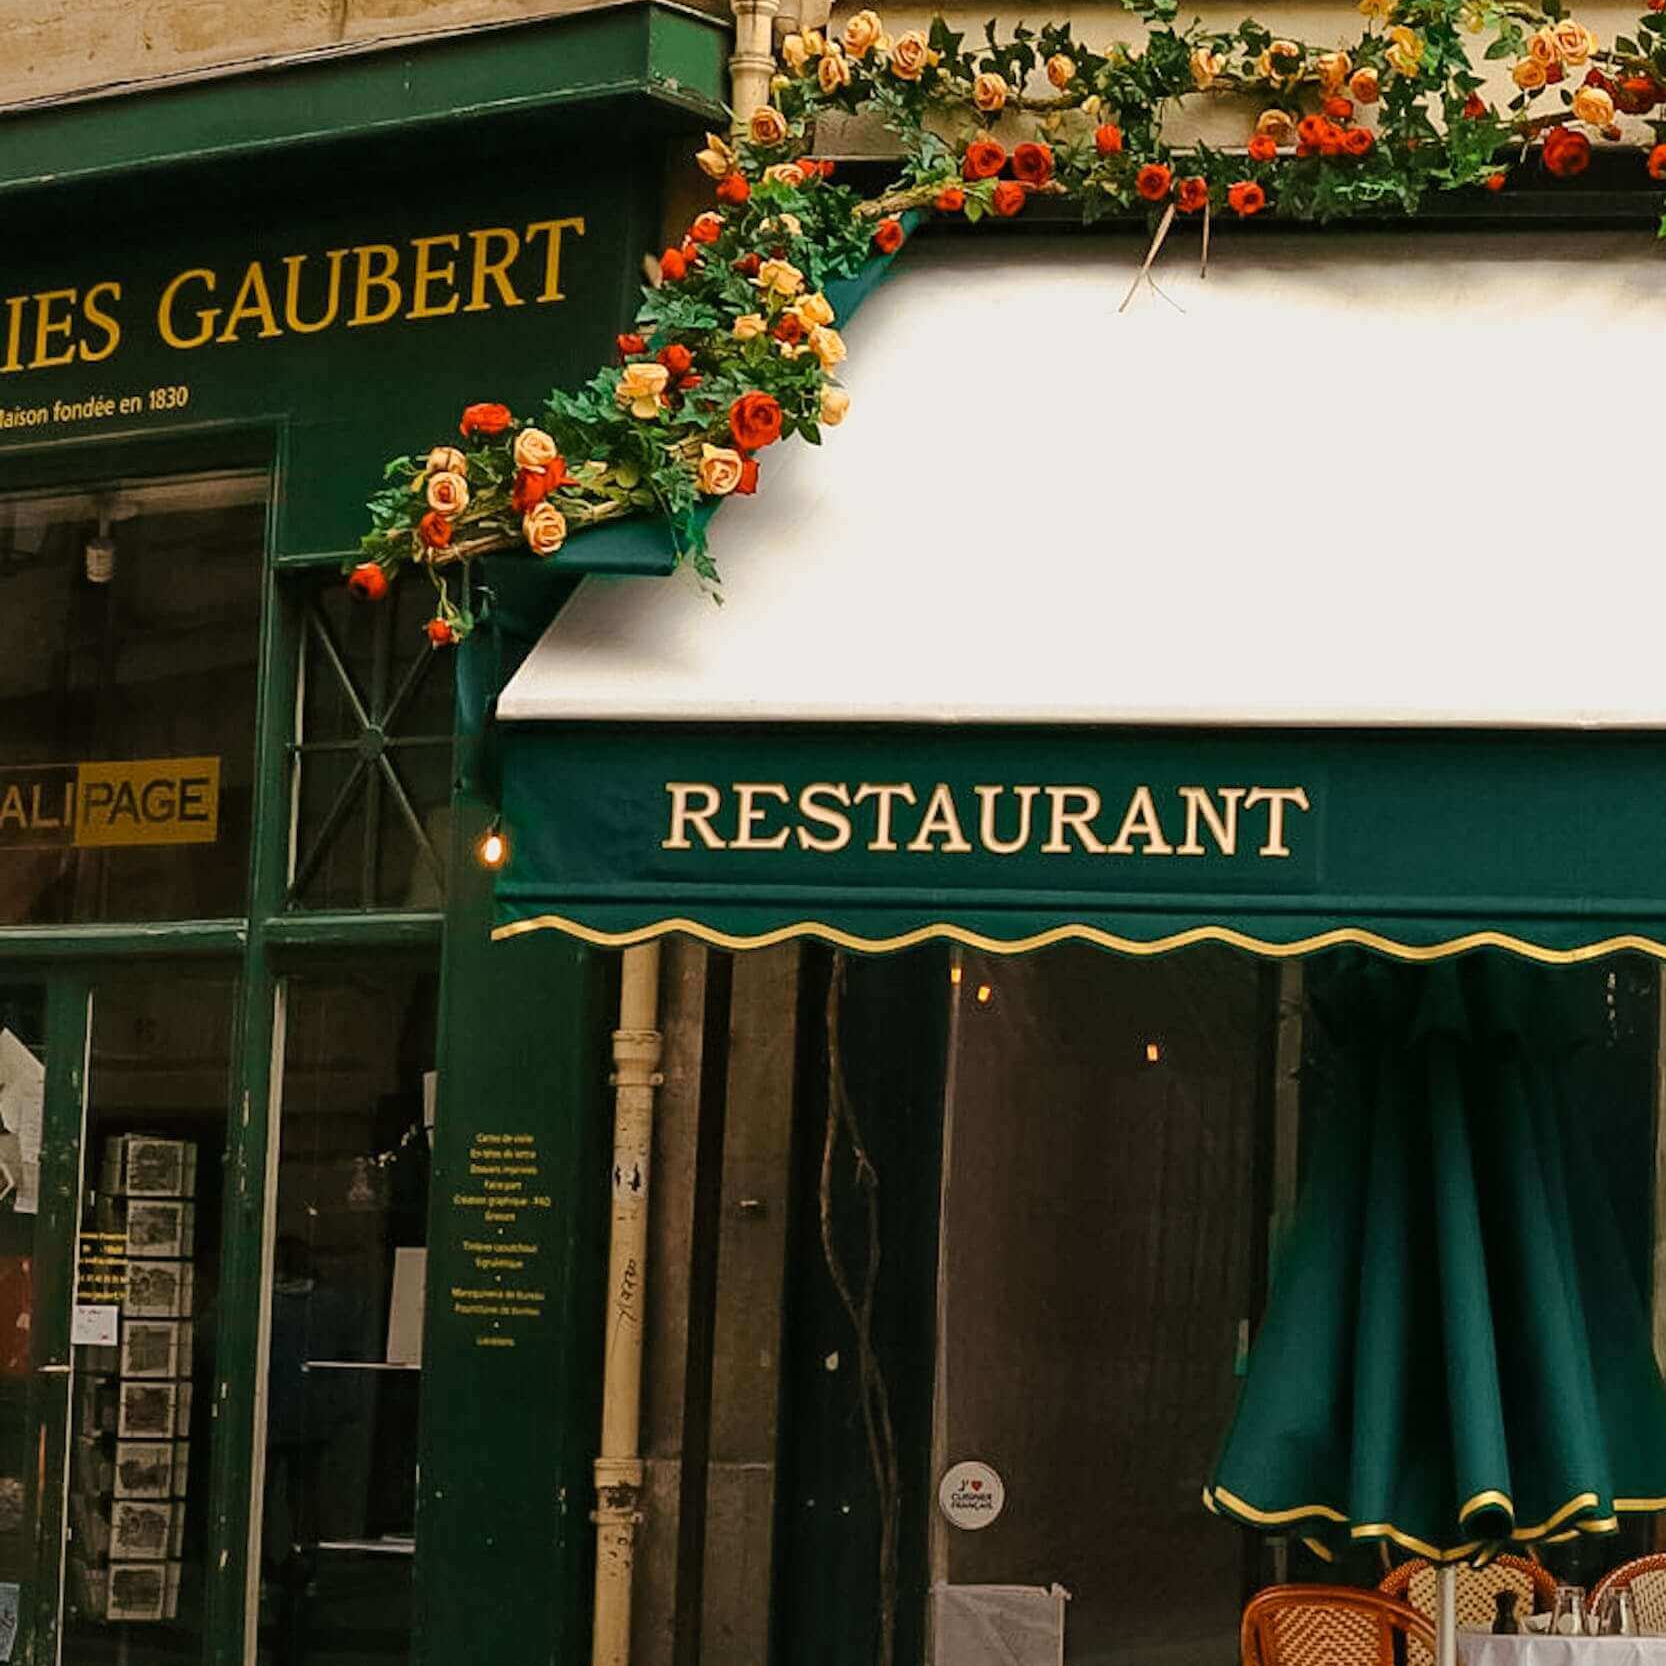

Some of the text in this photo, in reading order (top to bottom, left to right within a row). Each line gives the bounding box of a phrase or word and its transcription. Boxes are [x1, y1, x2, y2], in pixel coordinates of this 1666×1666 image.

[157, 217, 586, 350] GAUBERT
[53, 393, 114, 422] fondée
[119, 397, 142, 414] en
[149, 385, 189, 411] 1830
[661, 781, 1311, 858] RESTAURANT
